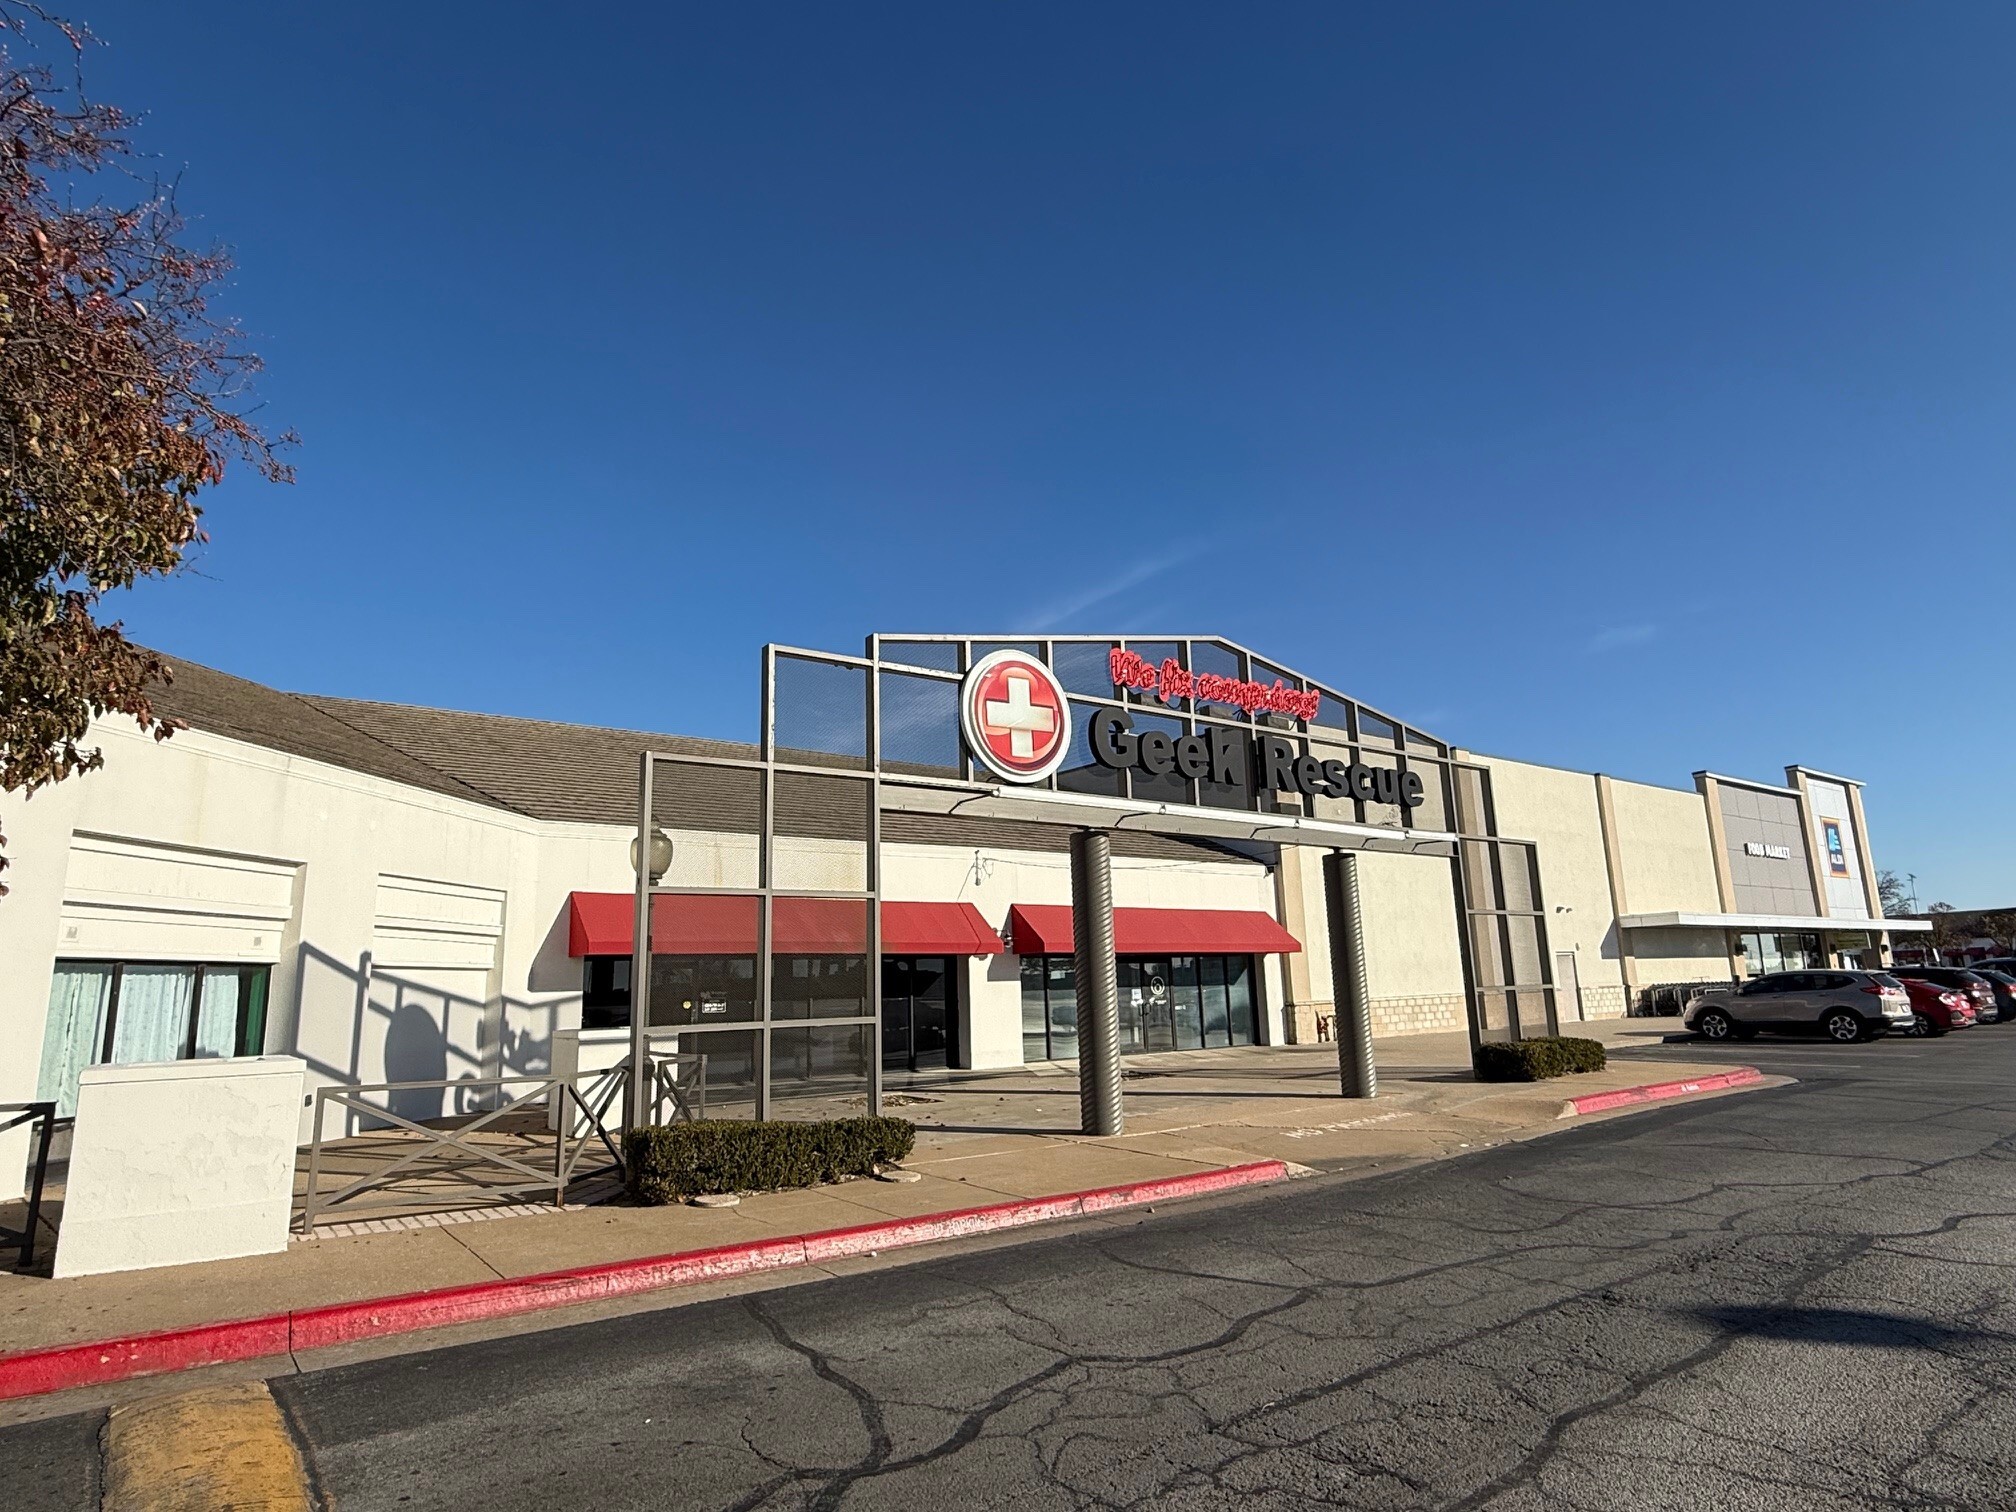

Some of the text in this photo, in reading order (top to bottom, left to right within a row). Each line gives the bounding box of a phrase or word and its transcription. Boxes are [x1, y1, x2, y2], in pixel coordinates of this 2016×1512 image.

[1110, 648, 1155, 690] We
[1088, 707, 1424, 807] Geek Rescue
[1746, 842, 1790, 859] FOOD MARKET
